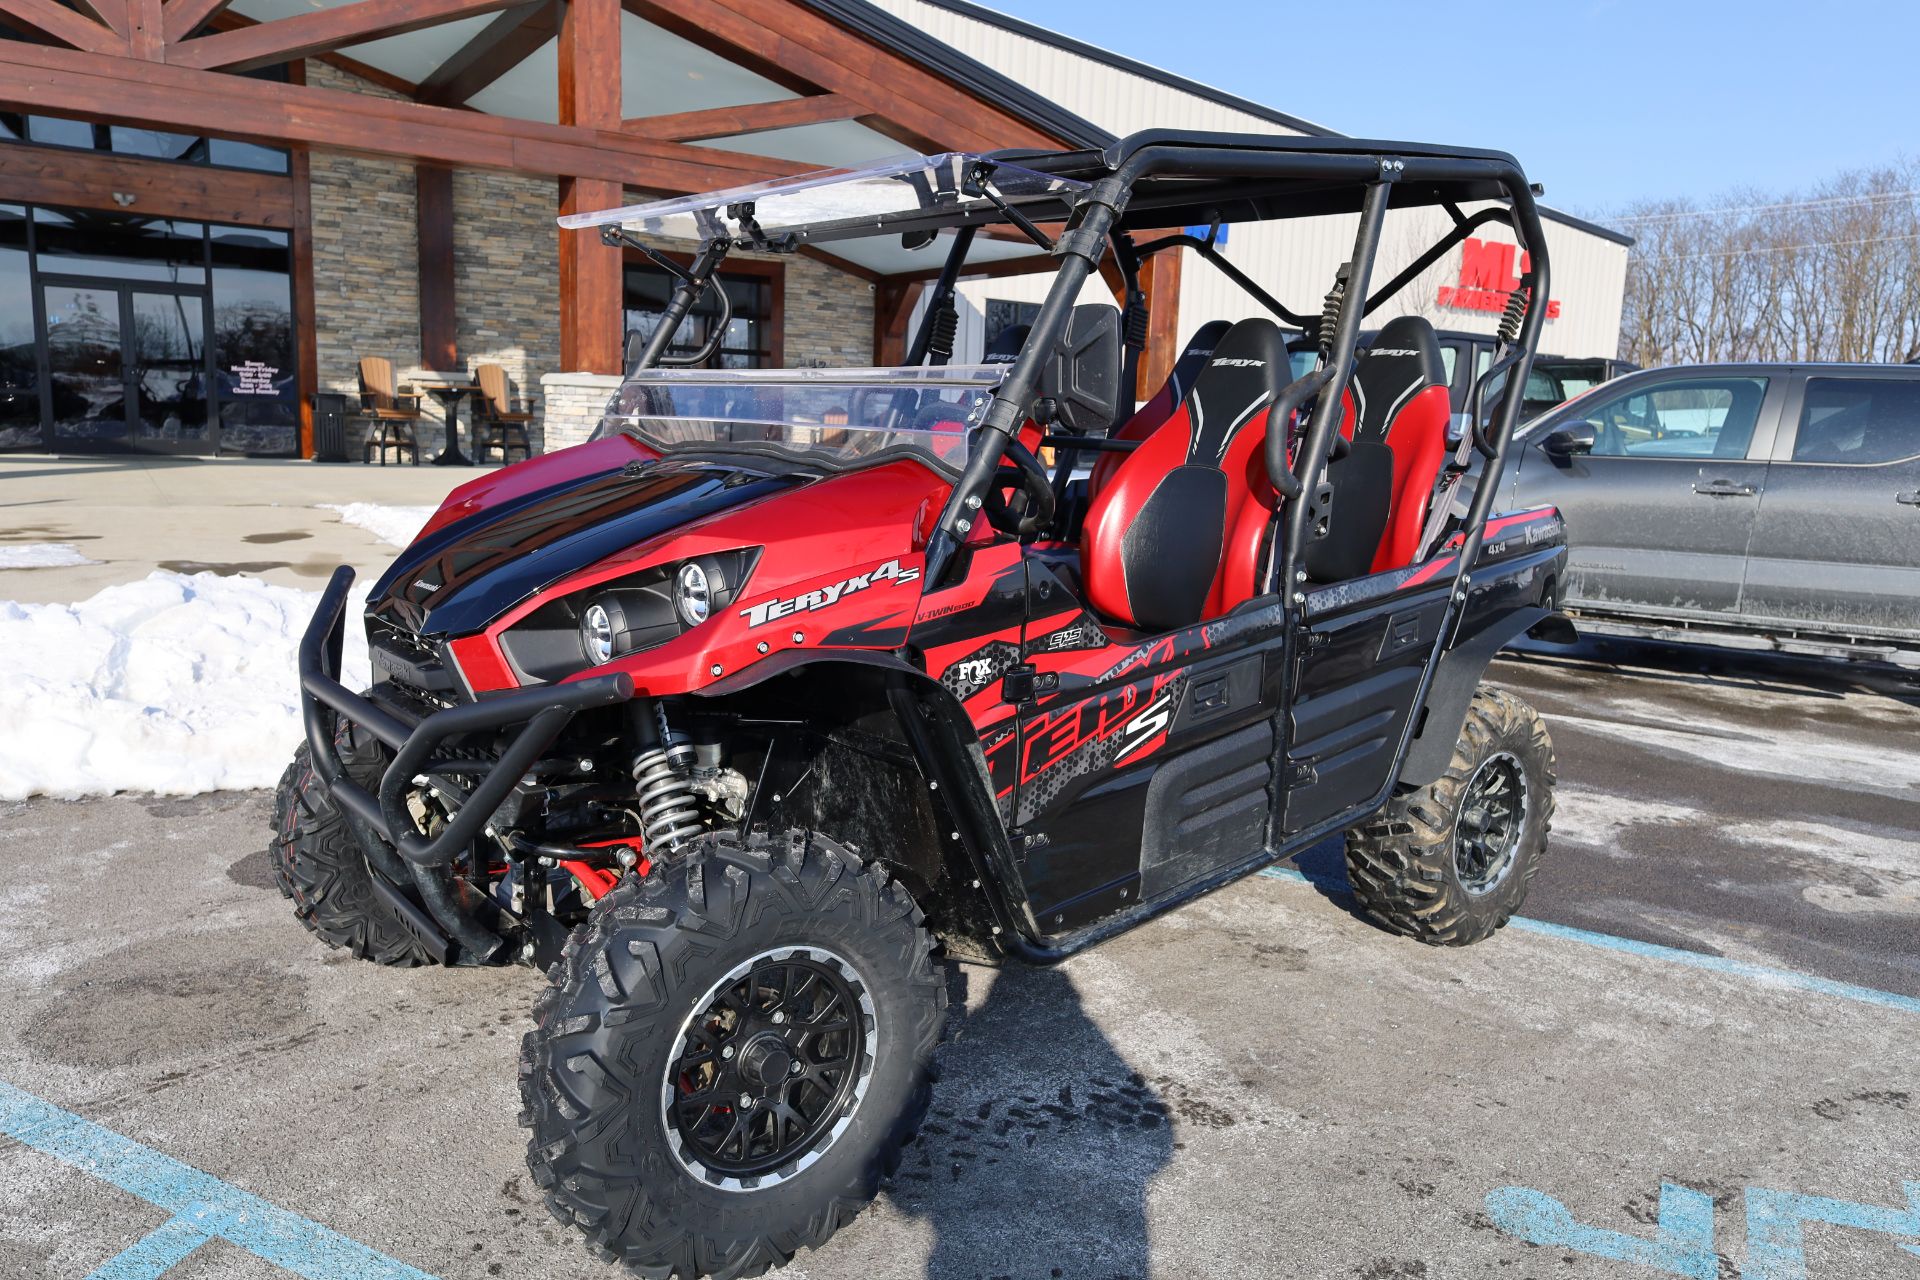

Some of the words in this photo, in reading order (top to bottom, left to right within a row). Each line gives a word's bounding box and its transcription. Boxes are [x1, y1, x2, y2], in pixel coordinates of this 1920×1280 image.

[1370, 348, 1420, 357] TERYX
[1212, 358, 1266, 367] TERYX
[1488, 541, 1506, 555] 4x4
[1524, 516, 1561, 545] Kawasaki
[958, 658, 993, 685] FOX
